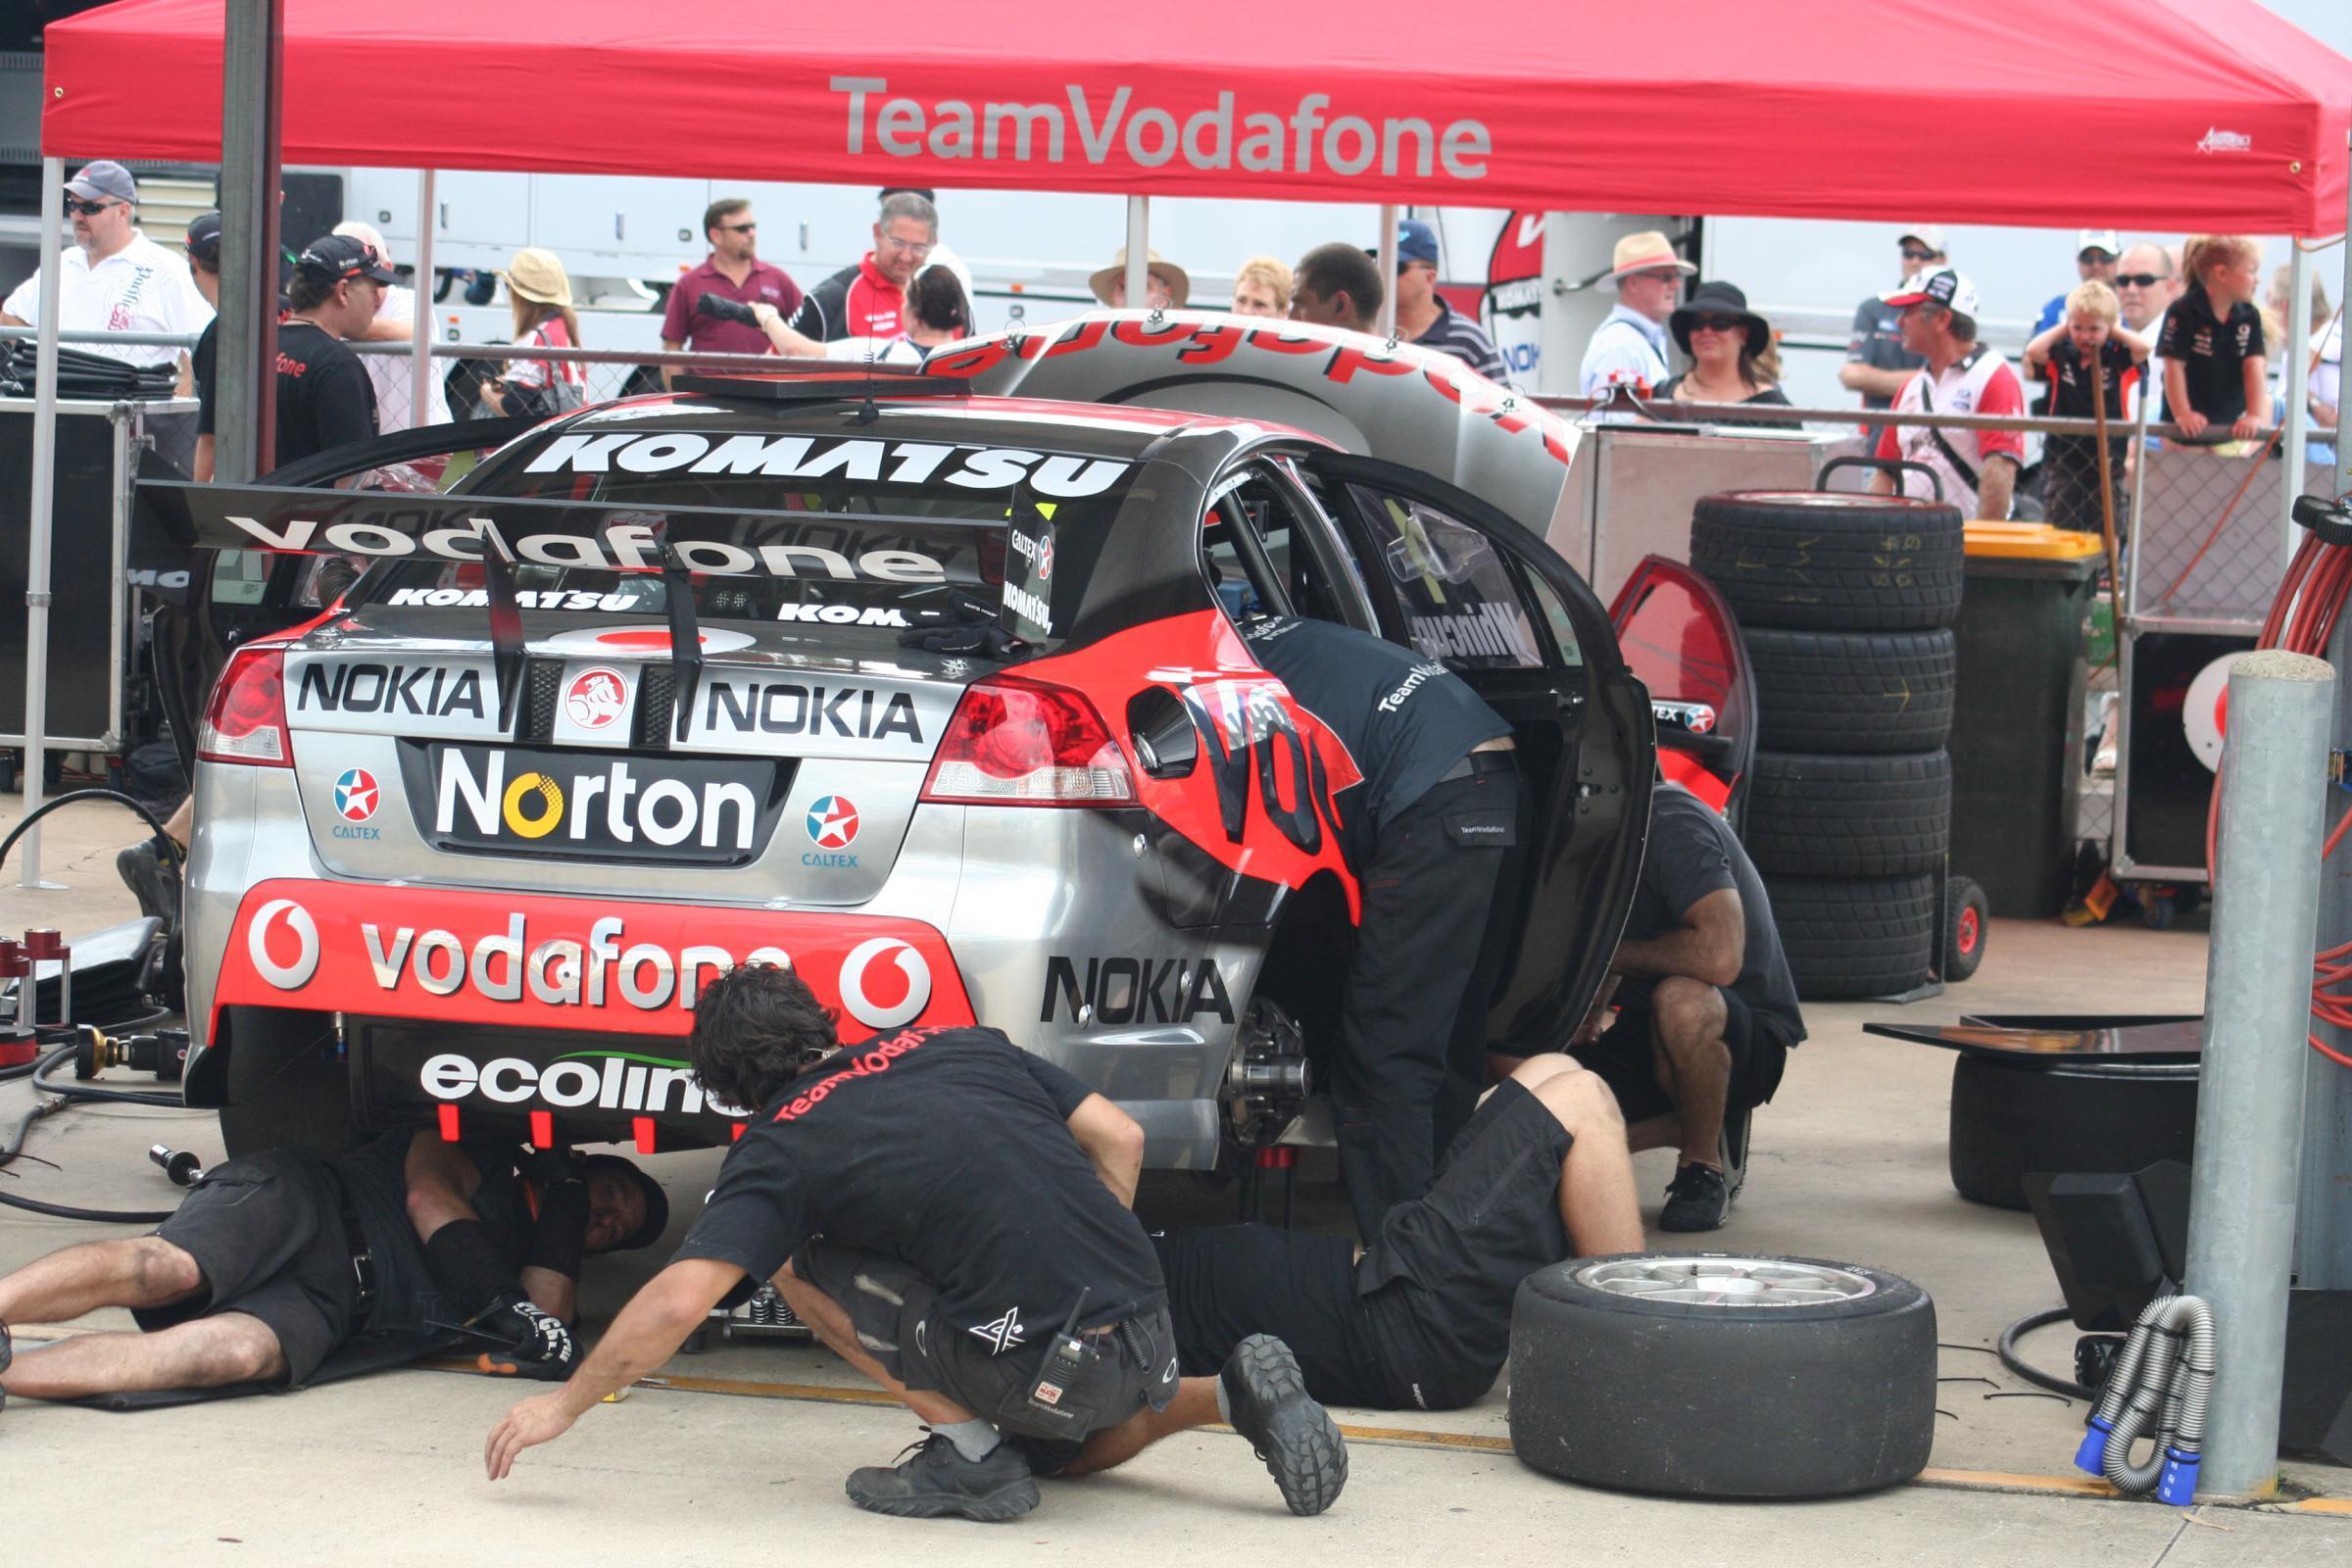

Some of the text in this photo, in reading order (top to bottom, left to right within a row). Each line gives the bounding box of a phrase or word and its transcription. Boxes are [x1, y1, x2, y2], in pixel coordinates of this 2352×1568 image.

[829, 75, 1493, 180] TeamVodafone
[1503, 343, 1541, 373] NOK
[523, 433, 1130, 497] KOMATSU
[224, 515, 947, 583] vodafone
[1011, 529, 1037, 562] CALTEX
[1003, 581, 1053, 635] KOMATSU
[296, 662, 487, 720] NOKIA
[706, 681, 925, 744] NOKIA
[1652, 706, 1679, 722] TEX
[436, 748, 756, 851] Norton
[332, 825, 381, 841] CALTEX
[802, 853, 858, 868] CALTEX
[362, 911, 793, 1009] vodafon
[1040, 956, 1236, 1026] NOKIA
[420, 1053, 755, 1118] ecolin
